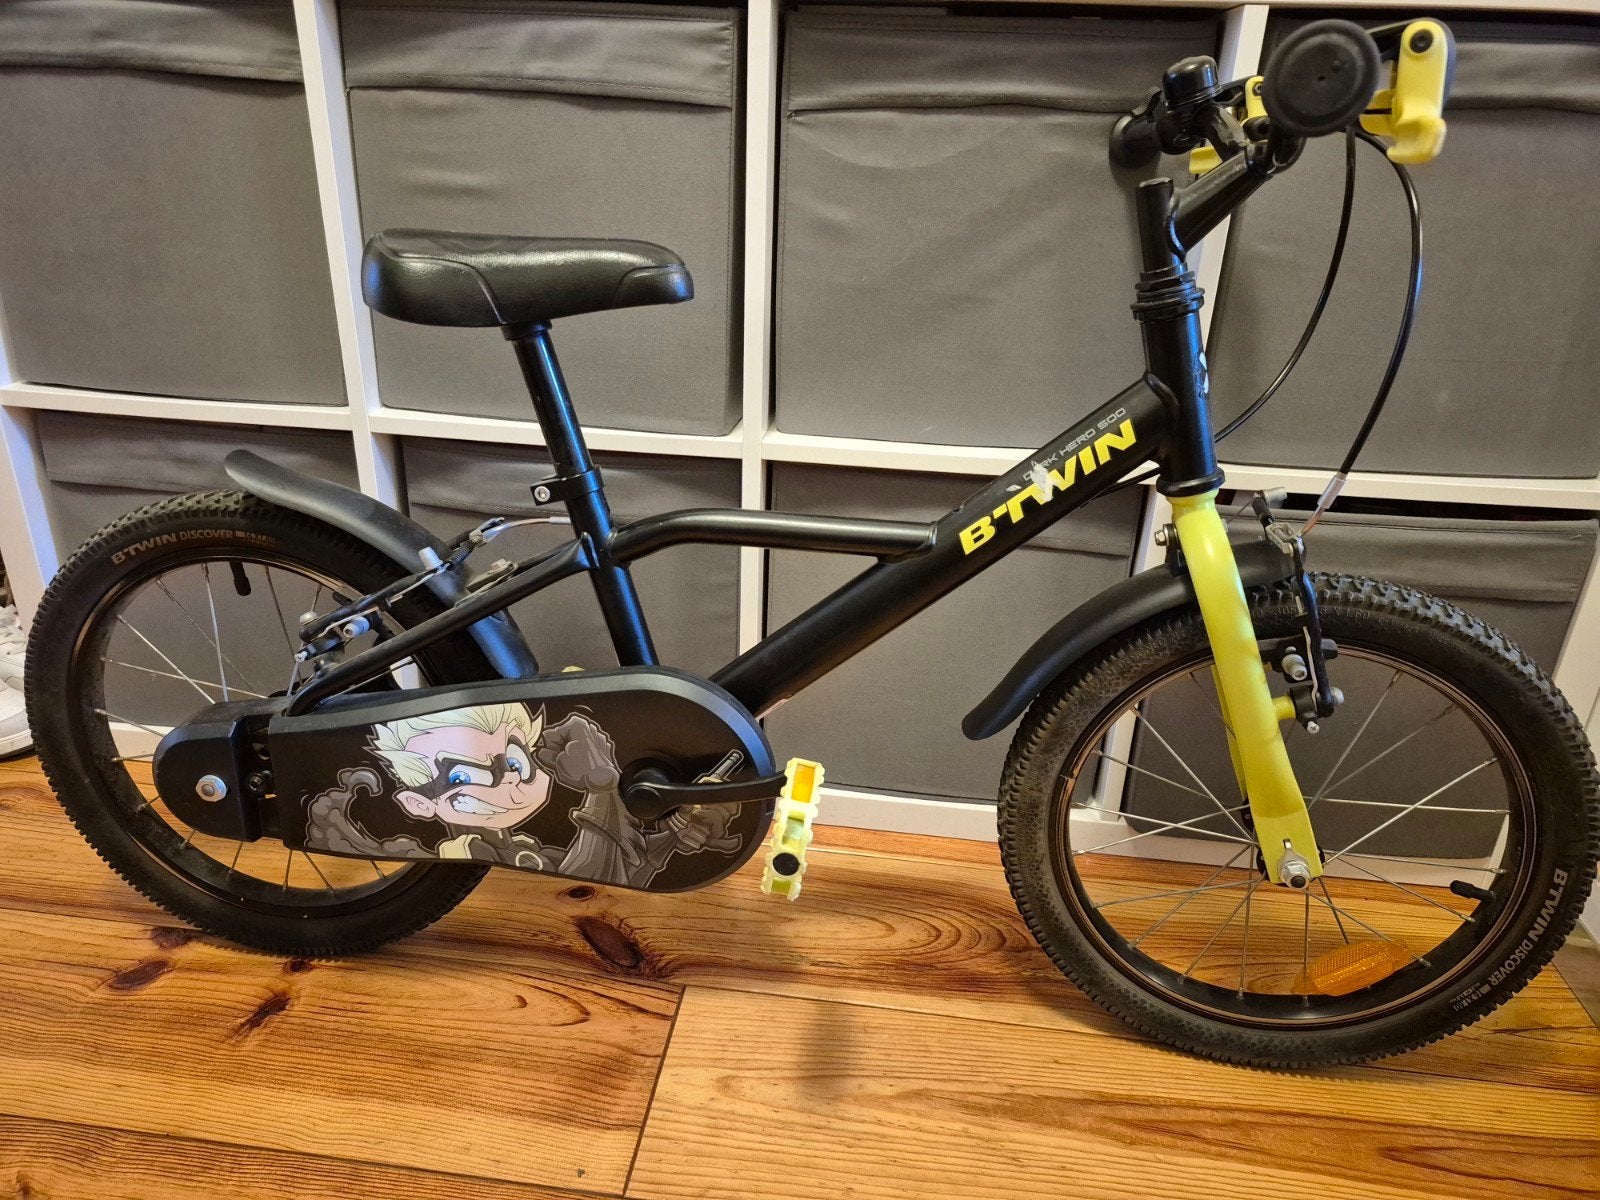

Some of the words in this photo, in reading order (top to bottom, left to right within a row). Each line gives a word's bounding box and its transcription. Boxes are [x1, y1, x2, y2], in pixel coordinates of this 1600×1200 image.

[1022, 453, 1058, 482] DRK
[1059, 428, 1096, 457] HERO
[1097, 407, 1127, 430] 500
[179, 529, 235, 542] DISCOVER
[1487, 938, 1534, 987] DISCOVER
